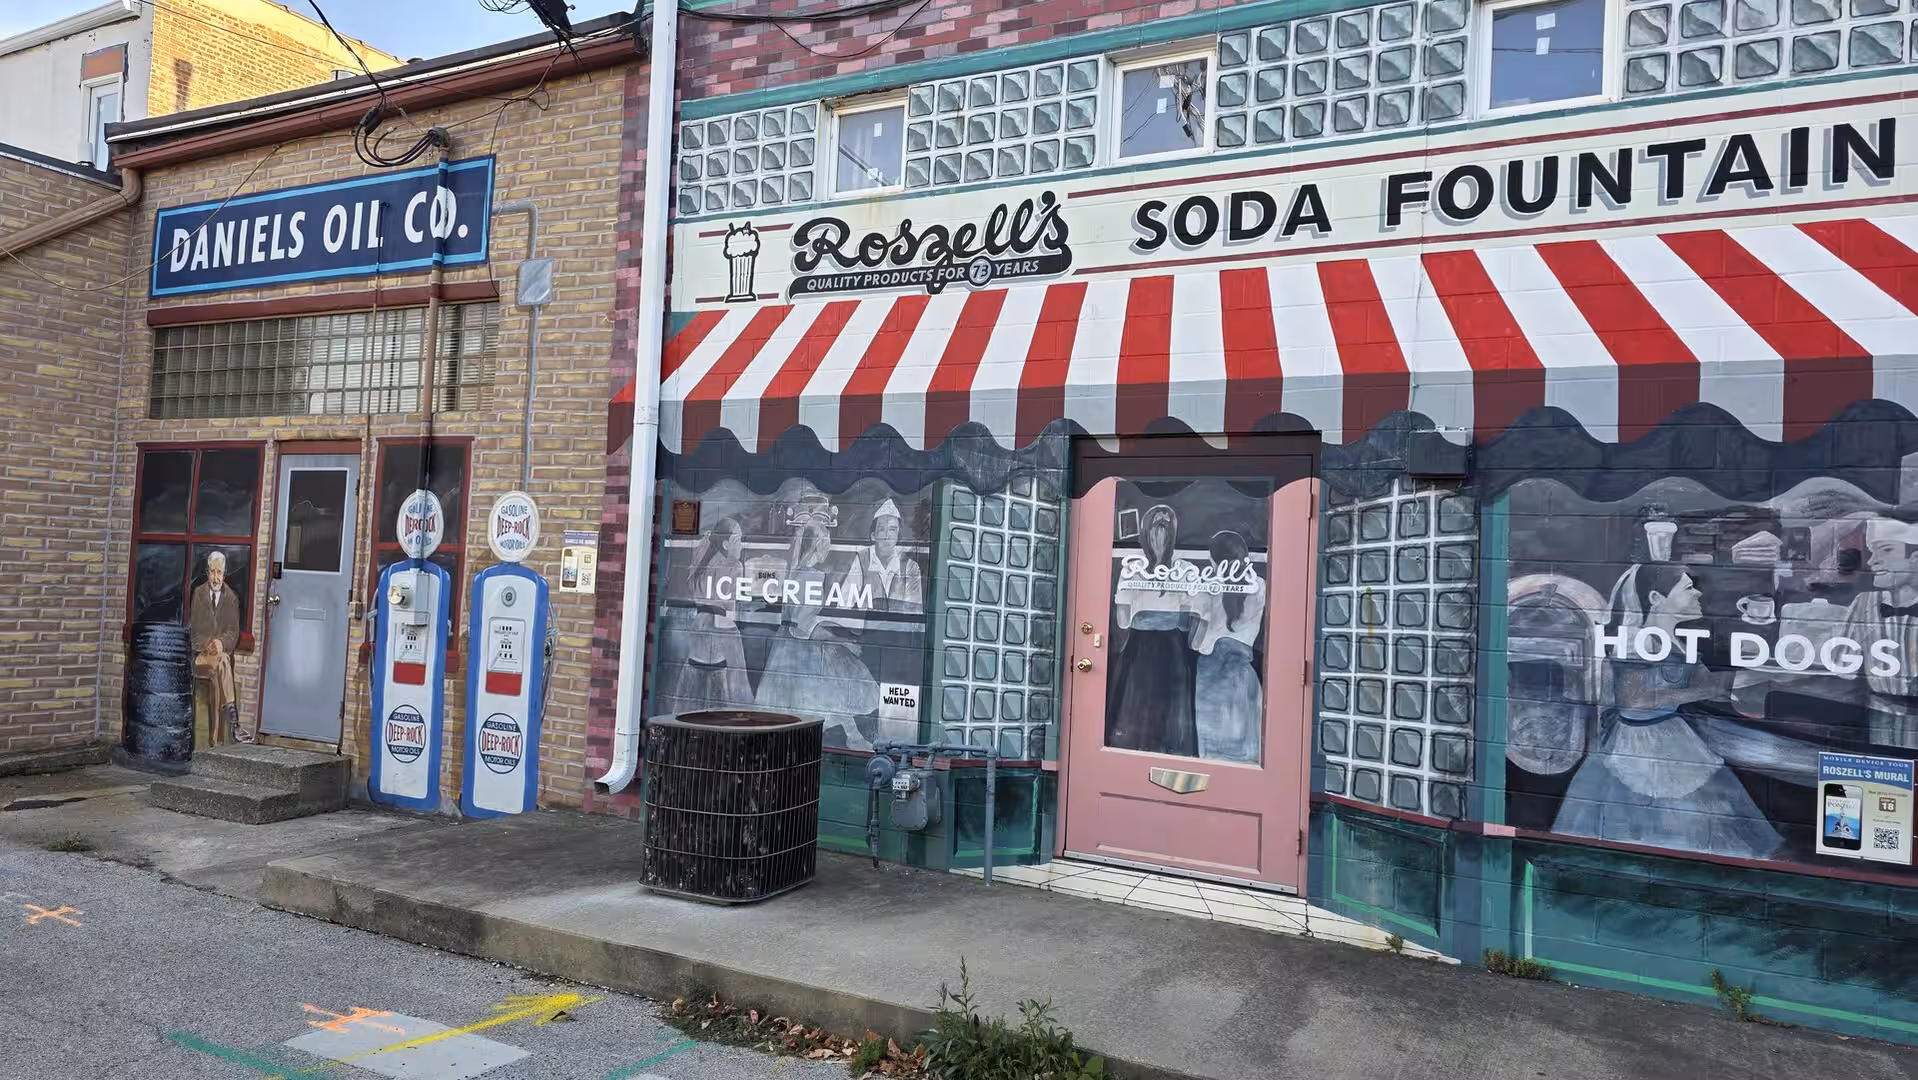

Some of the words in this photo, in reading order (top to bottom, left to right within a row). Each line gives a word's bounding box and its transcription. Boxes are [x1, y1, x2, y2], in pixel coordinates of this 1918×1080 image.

[1131, 183, 1333, 251] SODA
[1383, 117, 1897, 226] FOUNTAIN
[170, 211, 306, 273] DANIELS
[323, 199, 384, 254] OIL
[404, 185, 468, 244] CO.
[791, 190, 1069, 295] Roszell's
[806, 274, 862, 291] QUALITY
[863, 268, 934, 286] PRODUCTS
[936, 266, 966, 281] FOR
[972, 264, 989, 278] 73
[994, 260, 1040, 276] YEARS
[500, 504, 528, 517] GASOLINE
[496, 514, 531, 541] DEEP-ROCK
[758, 571, 776, 580] BUNS
[1120, 554, 1258, 596] Roszell's
[706, 575, 753, 602] ICE
[762, 579, 874, 609] CREAM
[1127, 581, 1156, 590] QUALITY
[1221, 585, 1245, 593] YEARS
[1594, 624, 1711, 664] HOT
[1730, 632, 1901, 677] DOGS
[888, 686, 910, 697] HELP
[883, 696, 916, 708] WANTED
[392, 713, 420, 722] GASOLINE
[388, 722, 423, 746] DEEP-ROCK
[486, 721, 516, 732] GASOLINE
[391, 745, 409, 753] MOTOR
[481, 730, 521, 757] DEEP-ROCK
[484, 755, 504, 764] MOTOR
[1823, 755, 1852, 763] MOBILE
[1856, 758, 1884, 766] DEVICE
[1822, 765, 1872, 779] ROSZELL'S
[1874, 770, 1910, 783] MURAL
[1881, 803, 1895, 811] 18
